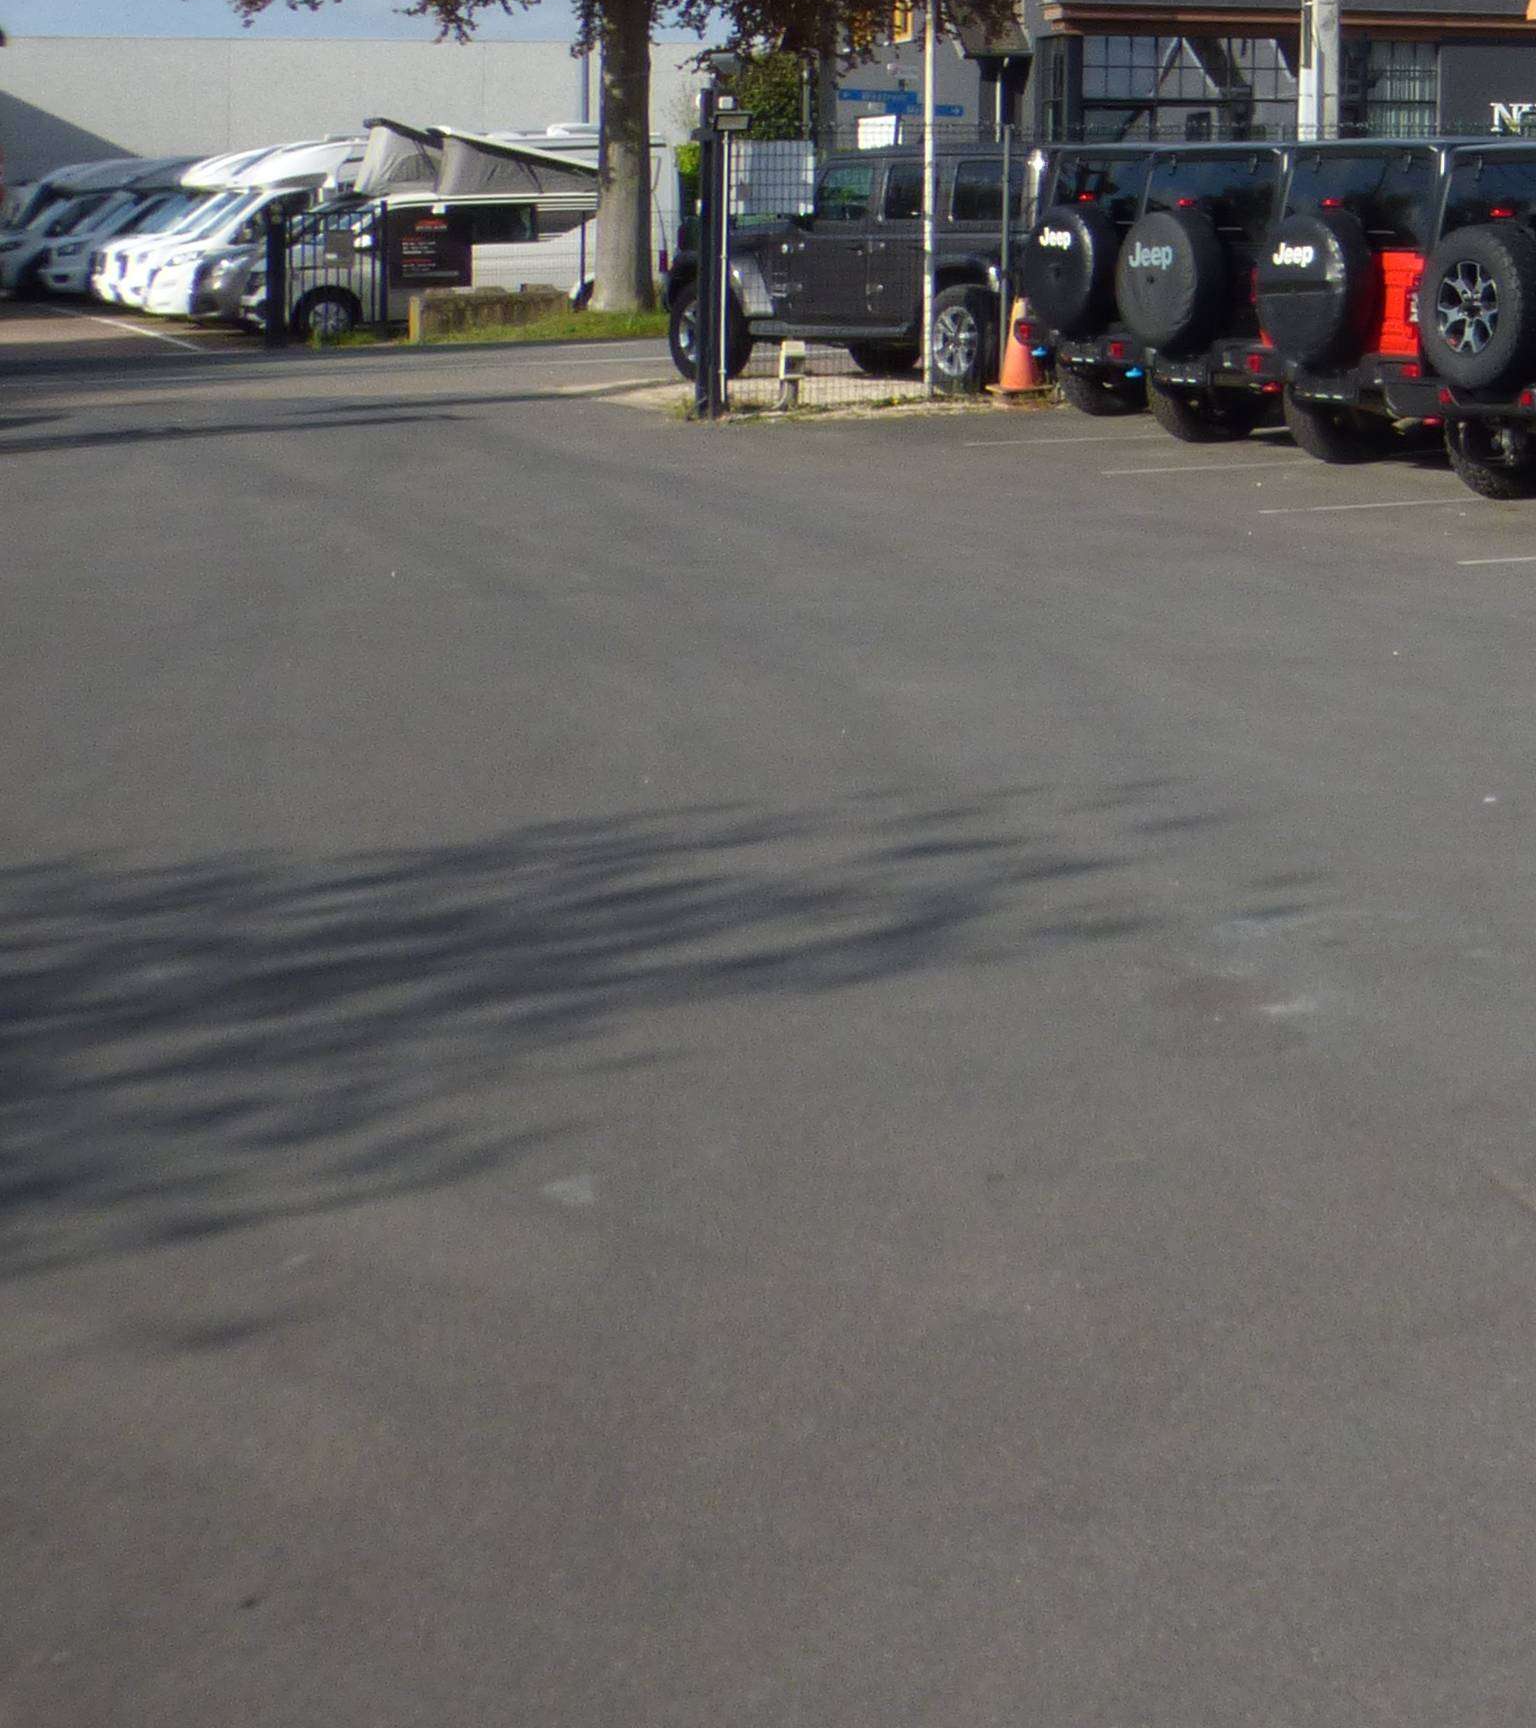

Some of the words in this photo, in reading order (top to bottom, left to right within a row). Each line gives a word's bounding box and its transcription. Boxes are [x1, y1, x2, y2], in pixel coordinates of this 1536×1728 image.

[1039, 226, 1071, 250] Jeep
[1128, 241, 1173, 270] Jeep
[1272, 242, 1314, 268] Jeep
